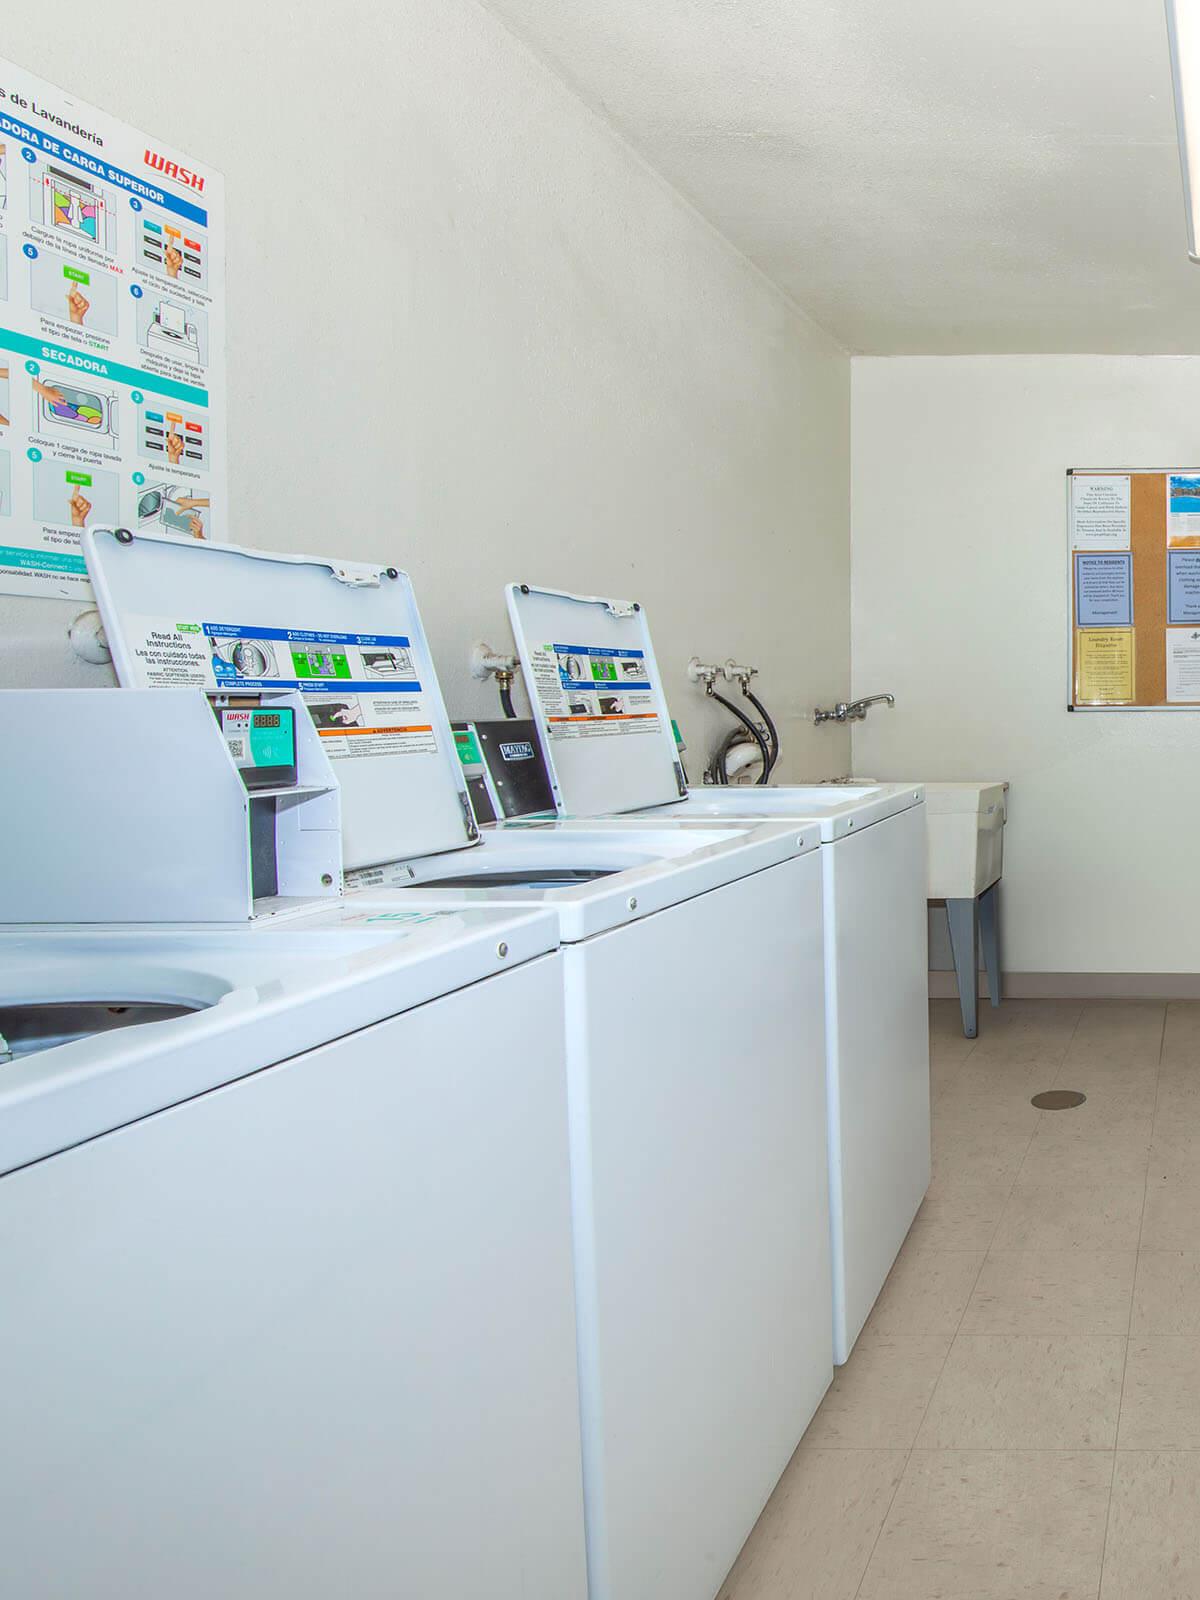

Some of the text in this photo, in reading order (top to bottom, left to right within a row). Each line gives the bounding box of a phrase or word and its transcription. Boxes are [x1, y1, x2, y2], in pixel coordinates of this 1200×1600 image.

[10, 93, 28, 109] de
[26, 150, 32, 161] 2
[42, 138, 61, 155] DE
[62, 148, 105, 177] CARGA
[107, 168, 165, 204] SUPERIOR
[143, 149, 205, 192] WASH
[132, 200, 139, 209] 3
[28, 247, 34, 256] 5
[40, 316, 55, 327] Para
[56, 322, 85, 338] empezar,
[48, 327, 61, 337] tipo
[61, 331, 70, 339] de
[40, 346, 109, 375] SECADORA
[28, 362, 35, 372] 2
[27, 435, 55, 448] Coloque
[61, 444, 79, 454] carga
[31, 450, 38, 459] 5
[42, 526, 57, 535] Para
[205, 625, 211, 636] 1
[151, 631, 184, 641] Read All
[287, 631, 294, 641] 2
[355, 635, 362, 645] 3
[146, 638, 192, 650] Instructions
[135, 649, 149, 657] Lea
[162, 651, 188, 659] cuidado
[145, 656, 156, 665] las
[298, 682, 305, 691] 5
[227, 713, 250, 721] WASH
[502, 743, 532, 756] MAYTAG
